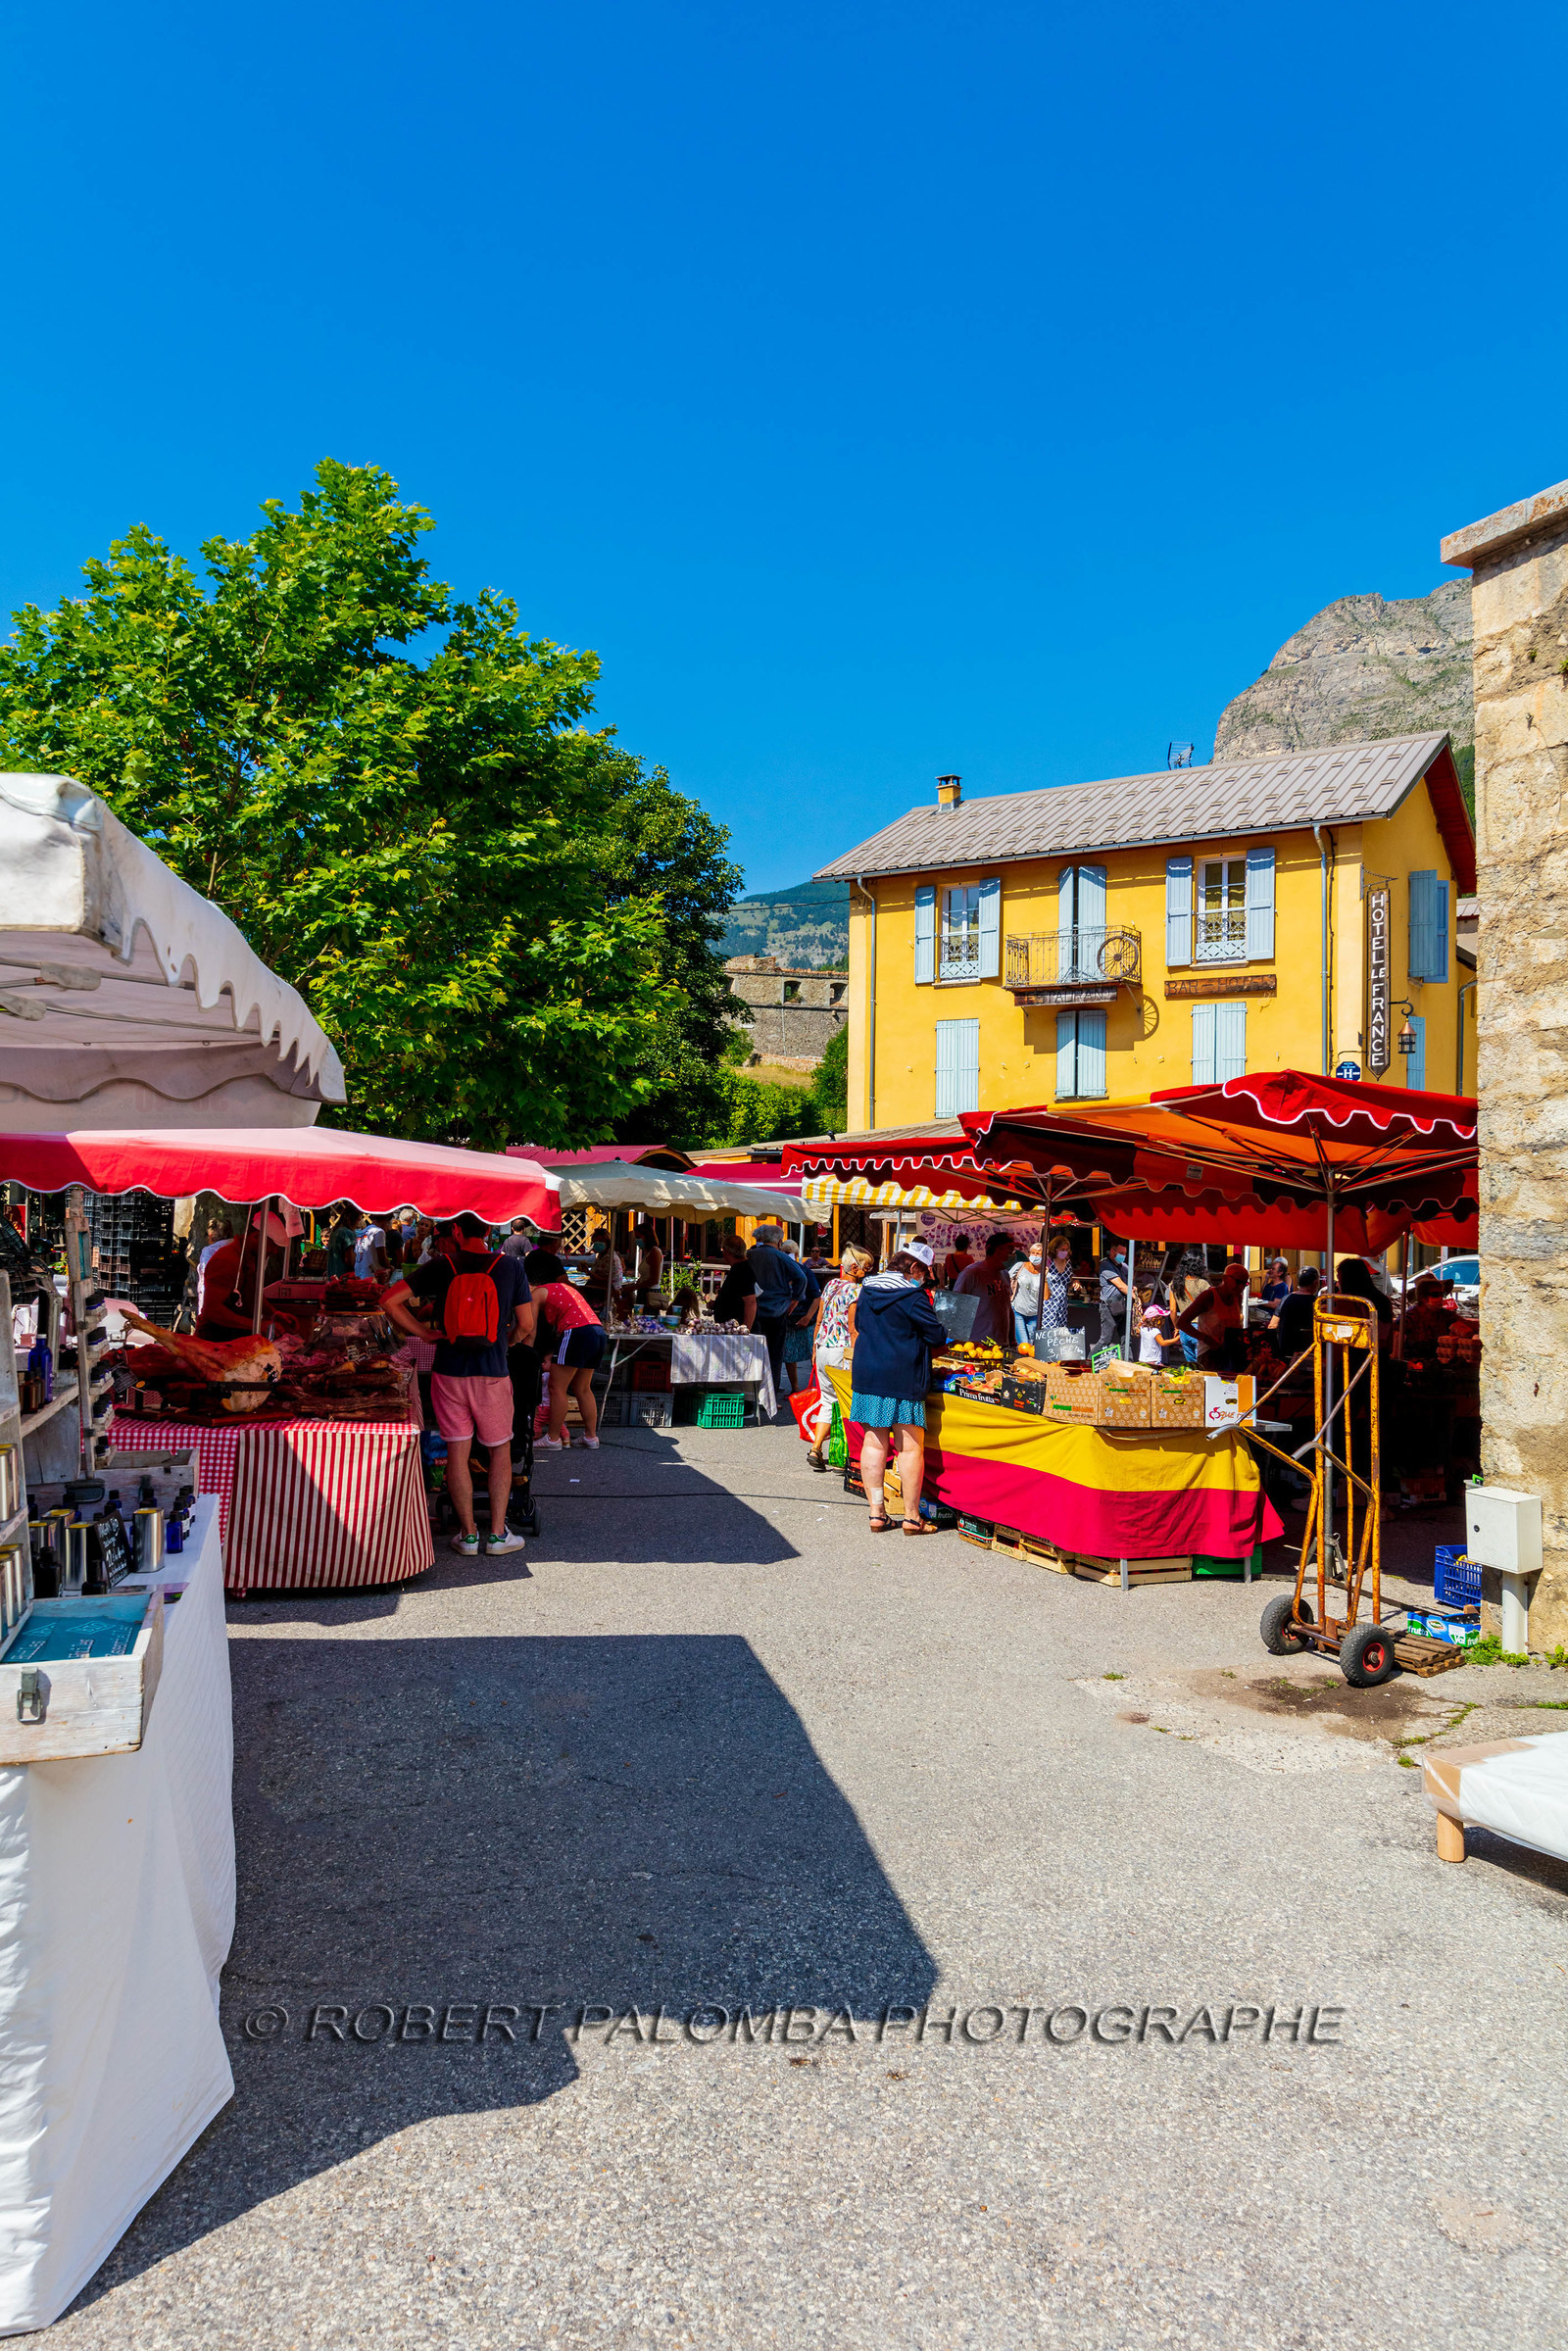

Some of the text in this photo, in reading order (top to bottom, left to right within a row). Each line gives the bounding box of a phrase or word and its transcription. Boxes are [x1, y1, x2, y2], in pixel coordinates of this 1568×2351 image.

[1371, 894, 1386, 1066] HOTEL LE FRANCE
[958, 1388, 996, 1404] Prima frutta
